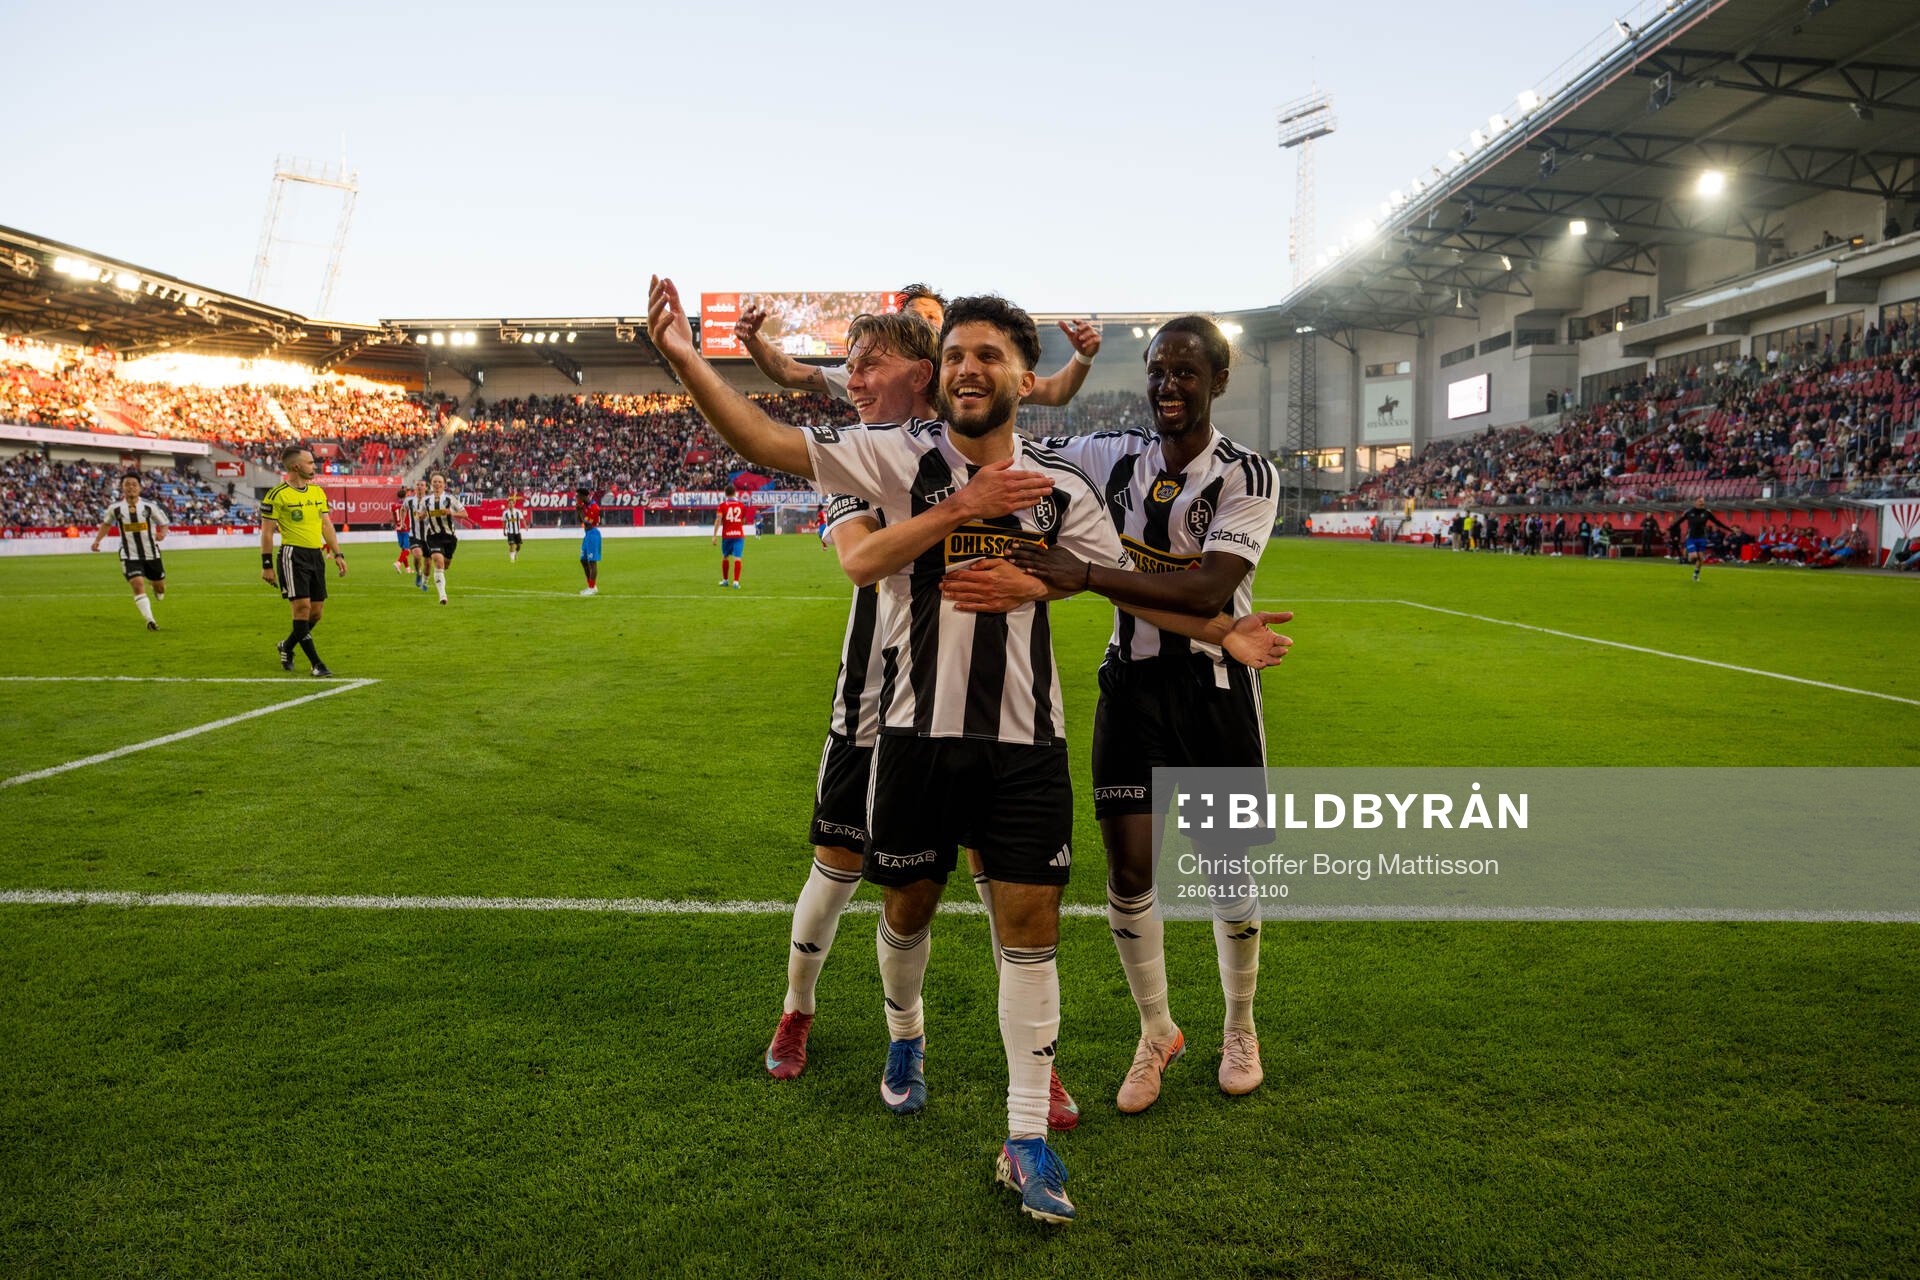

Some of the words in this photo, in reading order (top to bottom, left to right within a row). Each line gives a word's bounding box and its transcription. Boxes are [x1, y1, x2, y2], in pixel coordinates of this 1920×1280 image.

[725, 506, 742, 523] 42
[1208, 528, 1261, 557] stadium
[817, 818, 866, 842] TEAMA
[874, 851, 937, 869] TEAMAB
